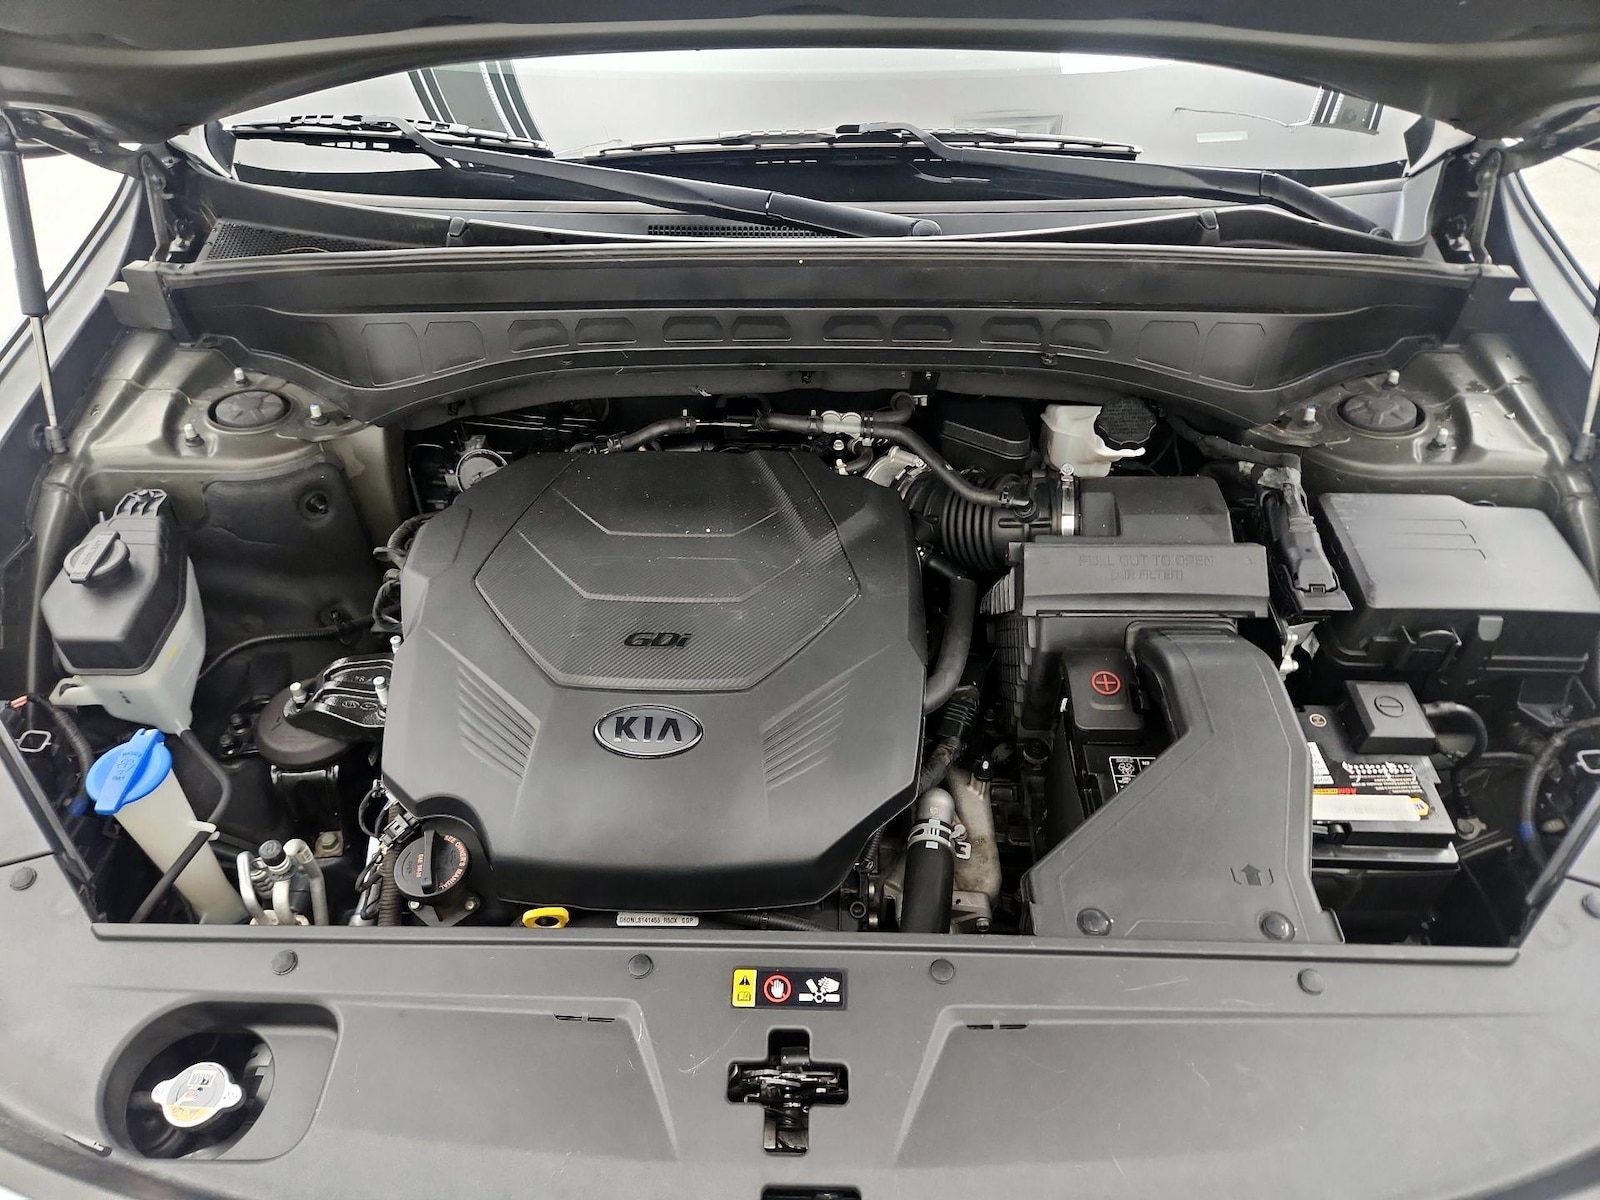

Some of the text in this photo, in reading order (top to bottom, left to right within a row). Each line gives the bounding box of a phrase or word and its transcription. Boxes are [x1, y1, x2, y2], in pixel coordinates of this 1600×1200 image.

[1079, 554, 1214, 567] PULL OUT TO OPEN
[623, 632, 692, 648] GDi
[614, 716, 682, 743] KIA
[439, 834, 467, 890] SEE OWNER'S MANUAL
